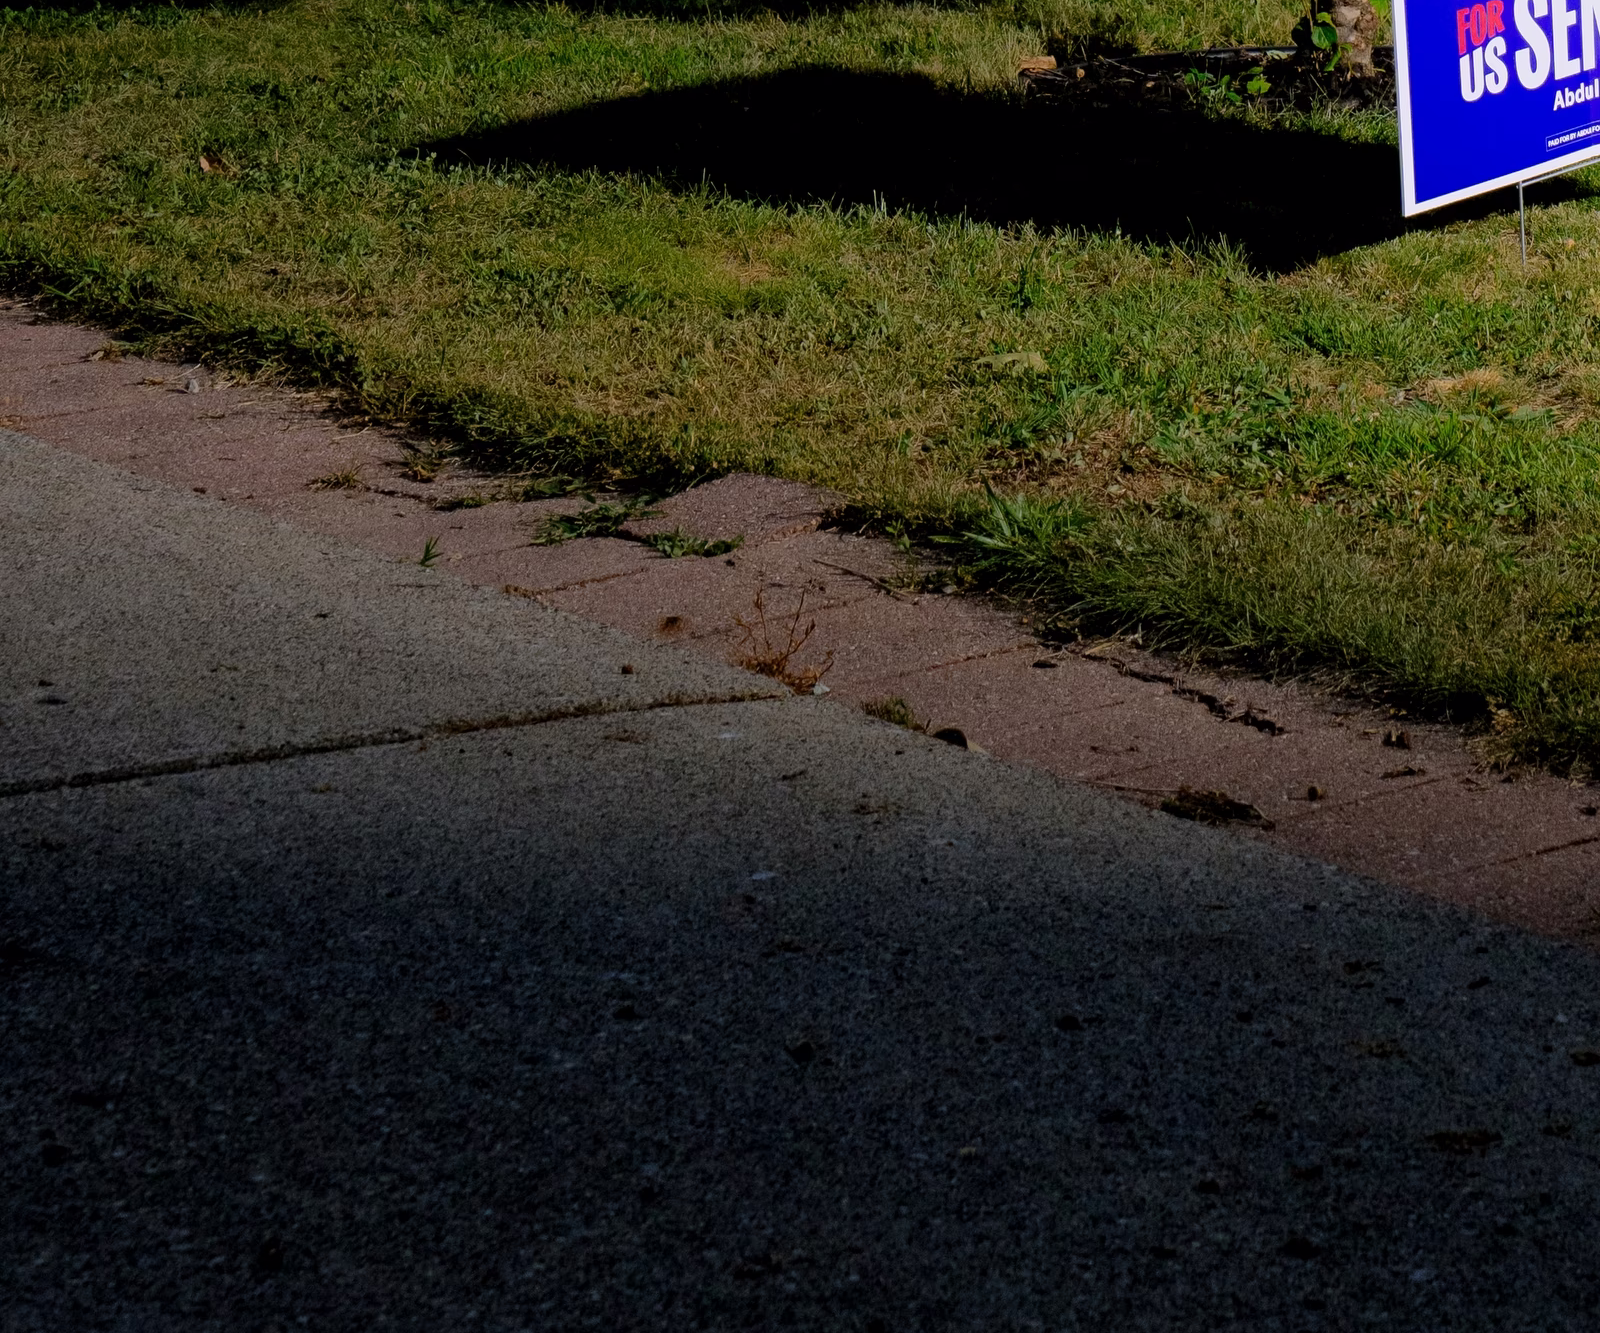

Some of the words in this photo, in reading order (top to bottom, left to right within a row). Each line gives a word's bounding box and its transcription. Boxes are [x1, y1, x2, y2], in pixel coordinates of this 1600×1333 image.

[1460, 36, 1509, 102] US
[1547, 138, 1560, 148] PAID
[1559, 134, 1570, 144] FOR
[1569, 132, 1577, 140] BY
[1576, 127, 1592, 138] ABDUL
